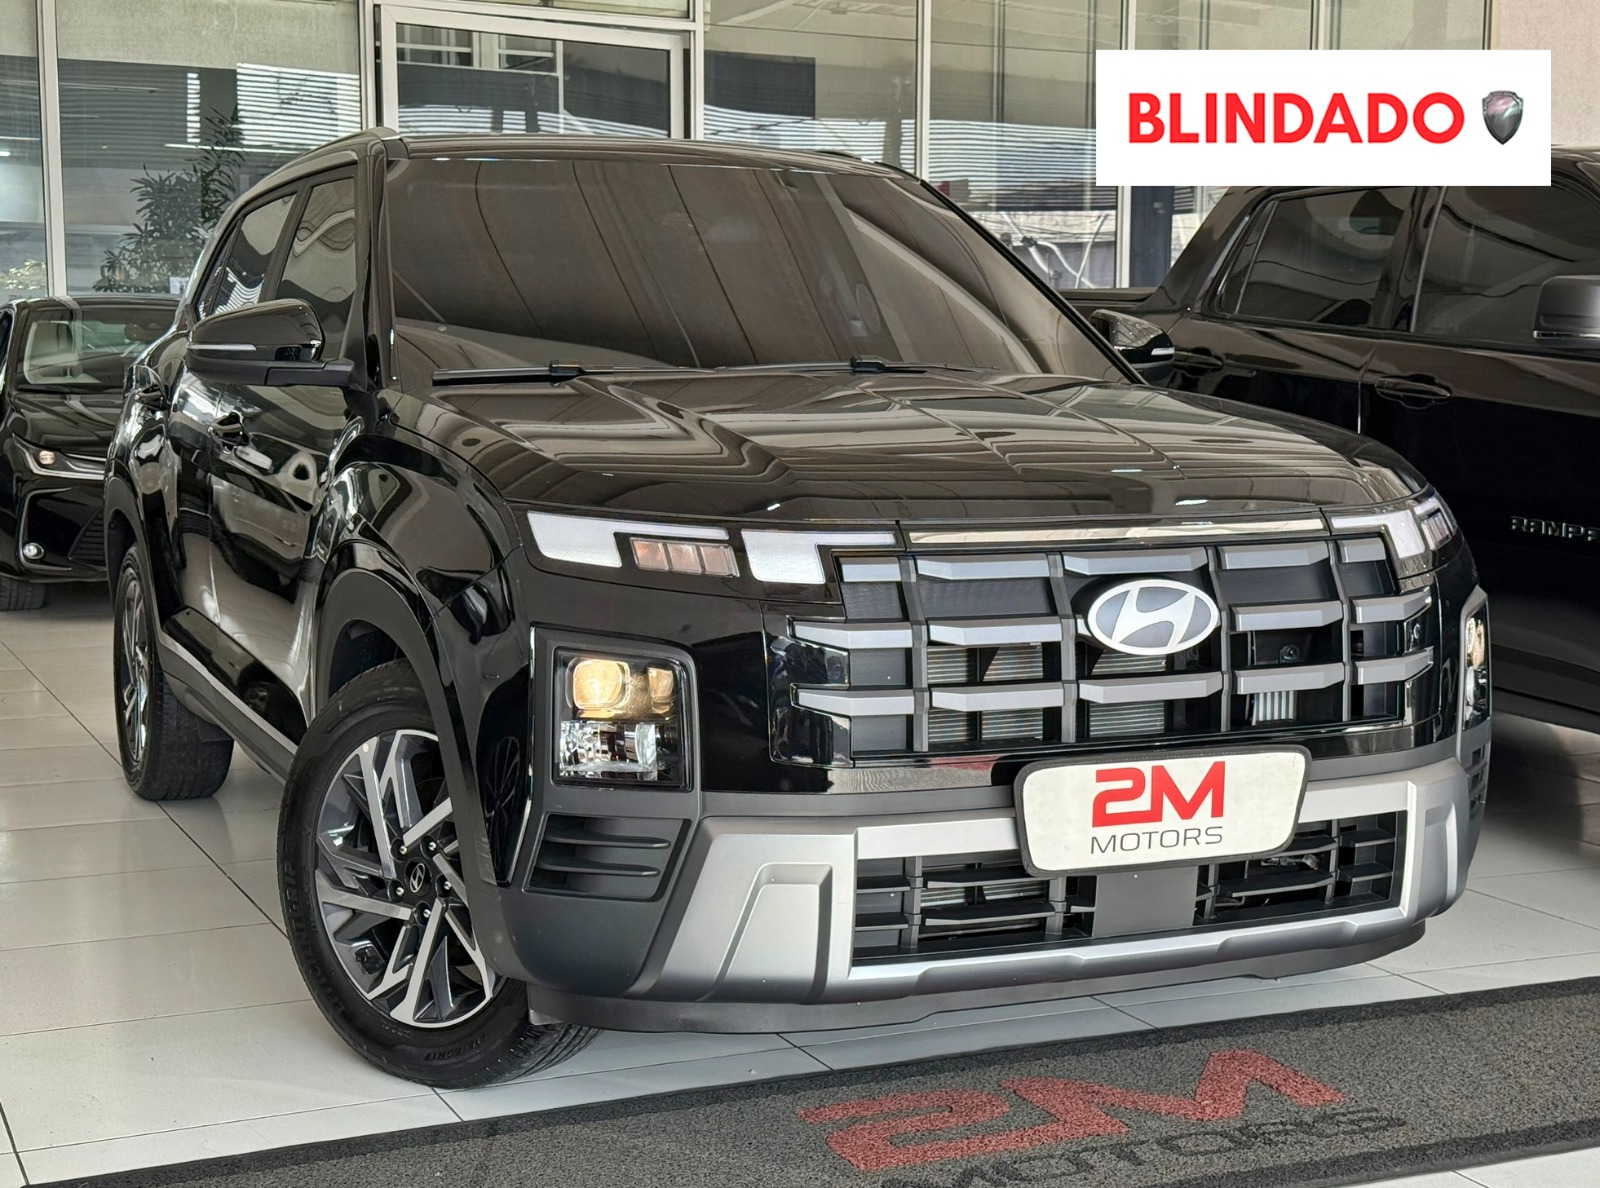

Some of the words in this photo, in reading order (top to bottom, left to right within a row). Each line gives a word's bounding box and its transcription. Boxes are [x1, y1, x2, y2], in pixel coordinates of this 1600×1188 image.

[1092, 760, 1226, 828] 2M
[1090, 826, 1224, 854] MOTORS
[797, 1047, 1346, 1172] 2M
